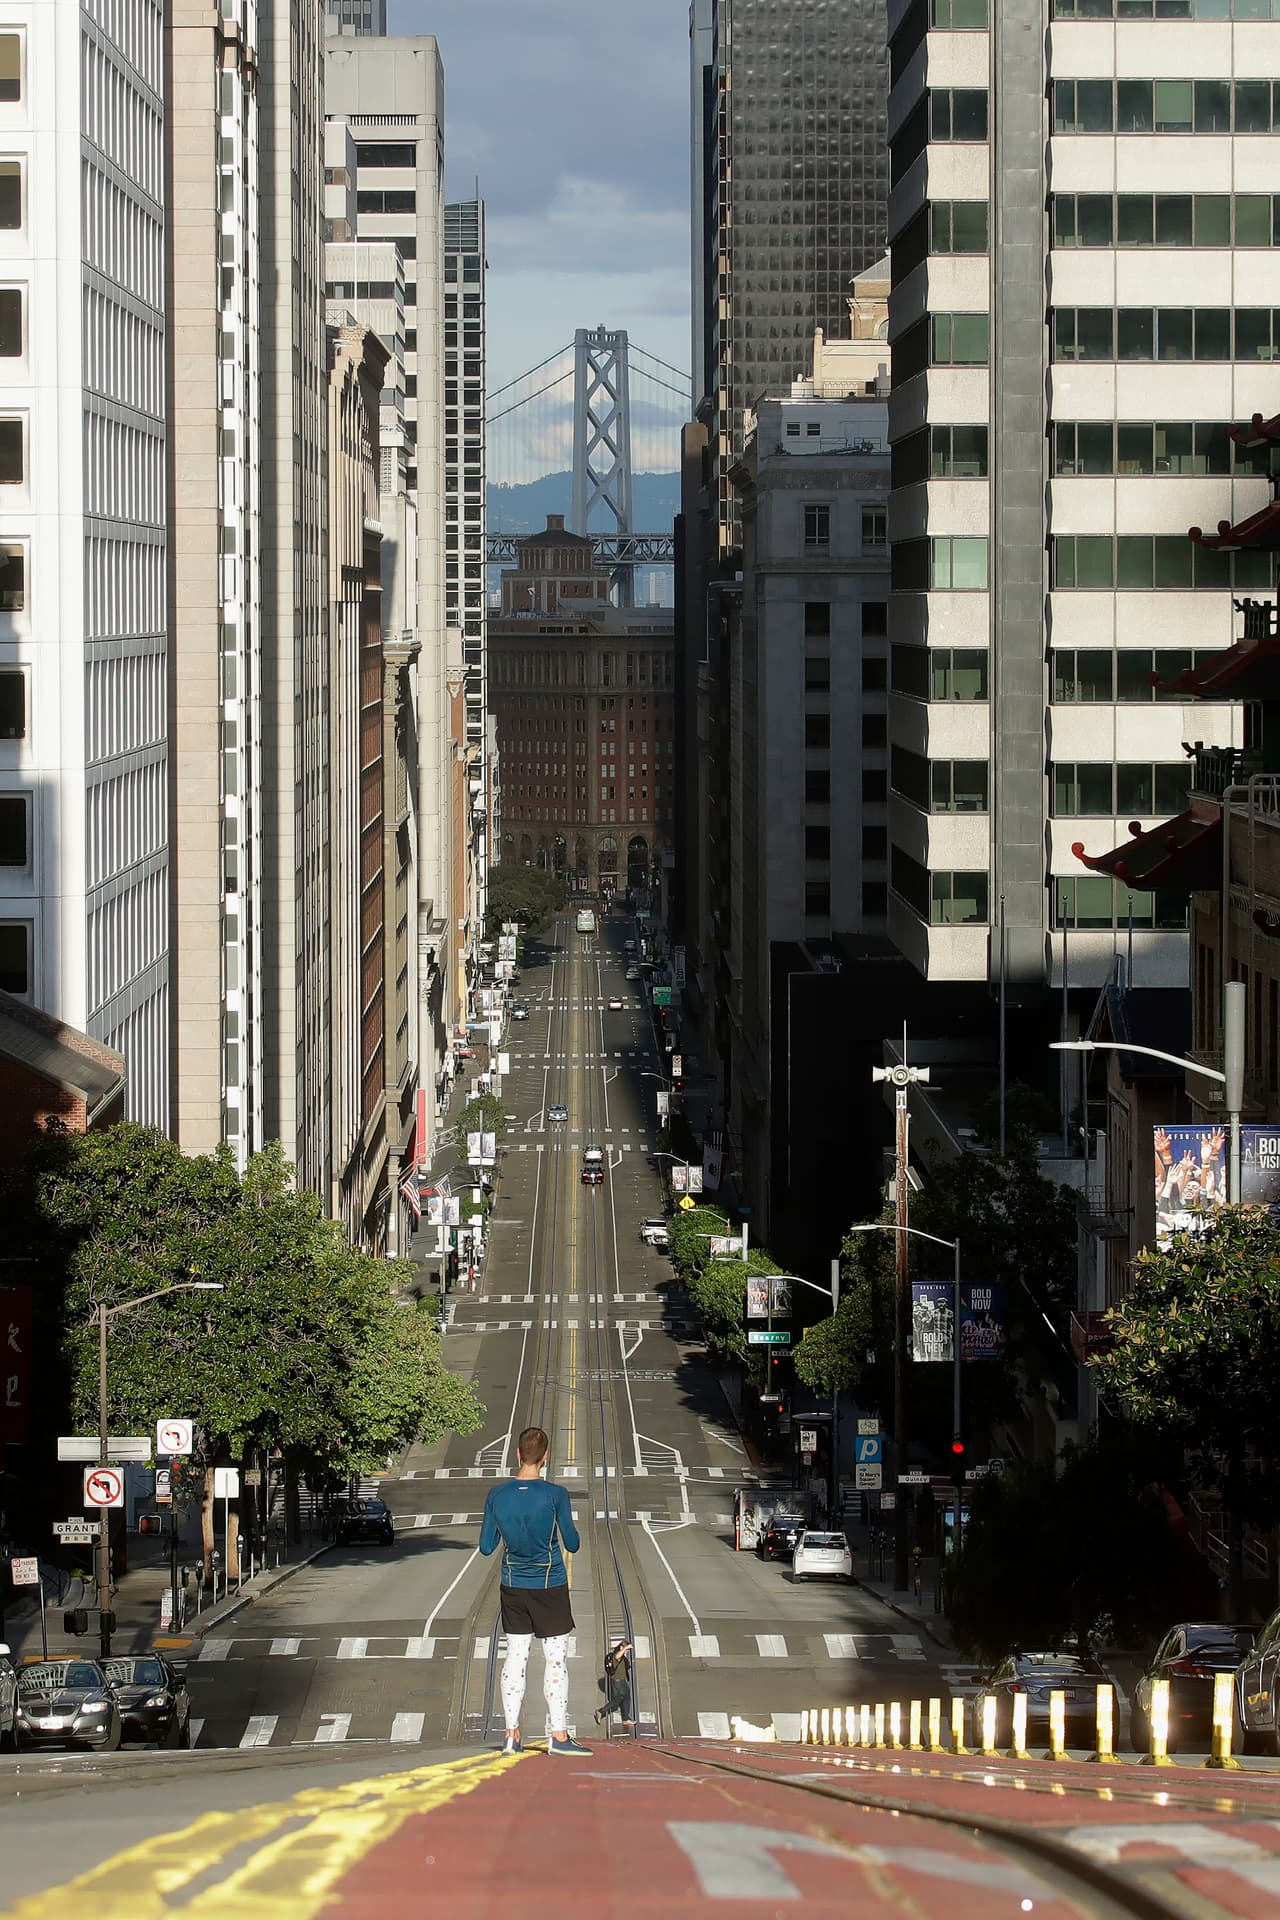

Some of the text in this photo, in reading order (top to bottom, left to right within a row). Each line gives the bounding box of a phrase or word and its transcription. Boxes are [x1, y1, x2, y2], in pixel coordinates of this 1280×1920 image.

[971, 1288, 992, 1299] BOLD
[971, 1299, 992, 1310] NOW
[923, 1332, 944, 1343] BOLD
[923, 1342, 944, 1353] THEN
[57, 1524, 96, 1533] GRANT
